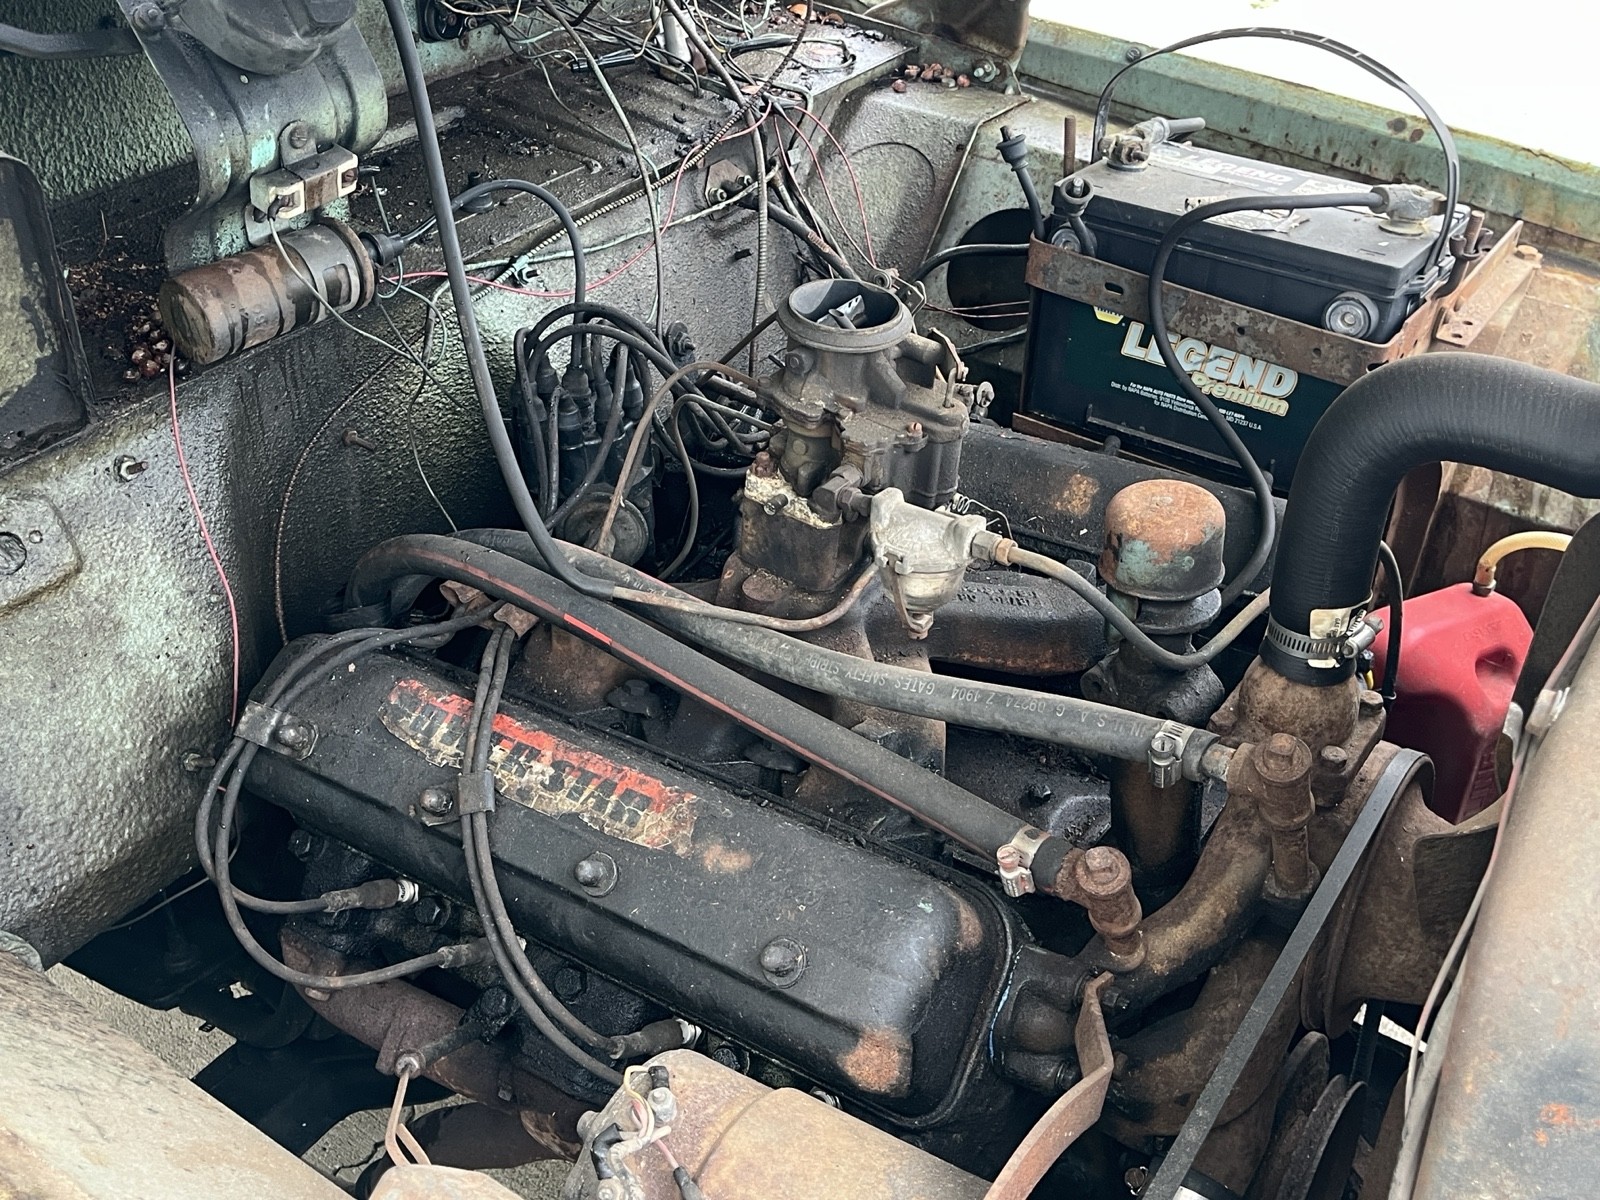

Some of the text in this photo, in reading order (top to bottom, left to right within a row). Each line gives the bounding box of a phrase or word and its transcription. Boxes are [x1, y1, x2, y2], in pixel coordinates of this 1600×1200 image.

[1191, 371, 1290, 418] Premium
[844, 670, 887, 687] SAFETY
[894, 675, 936, 695] GATES
